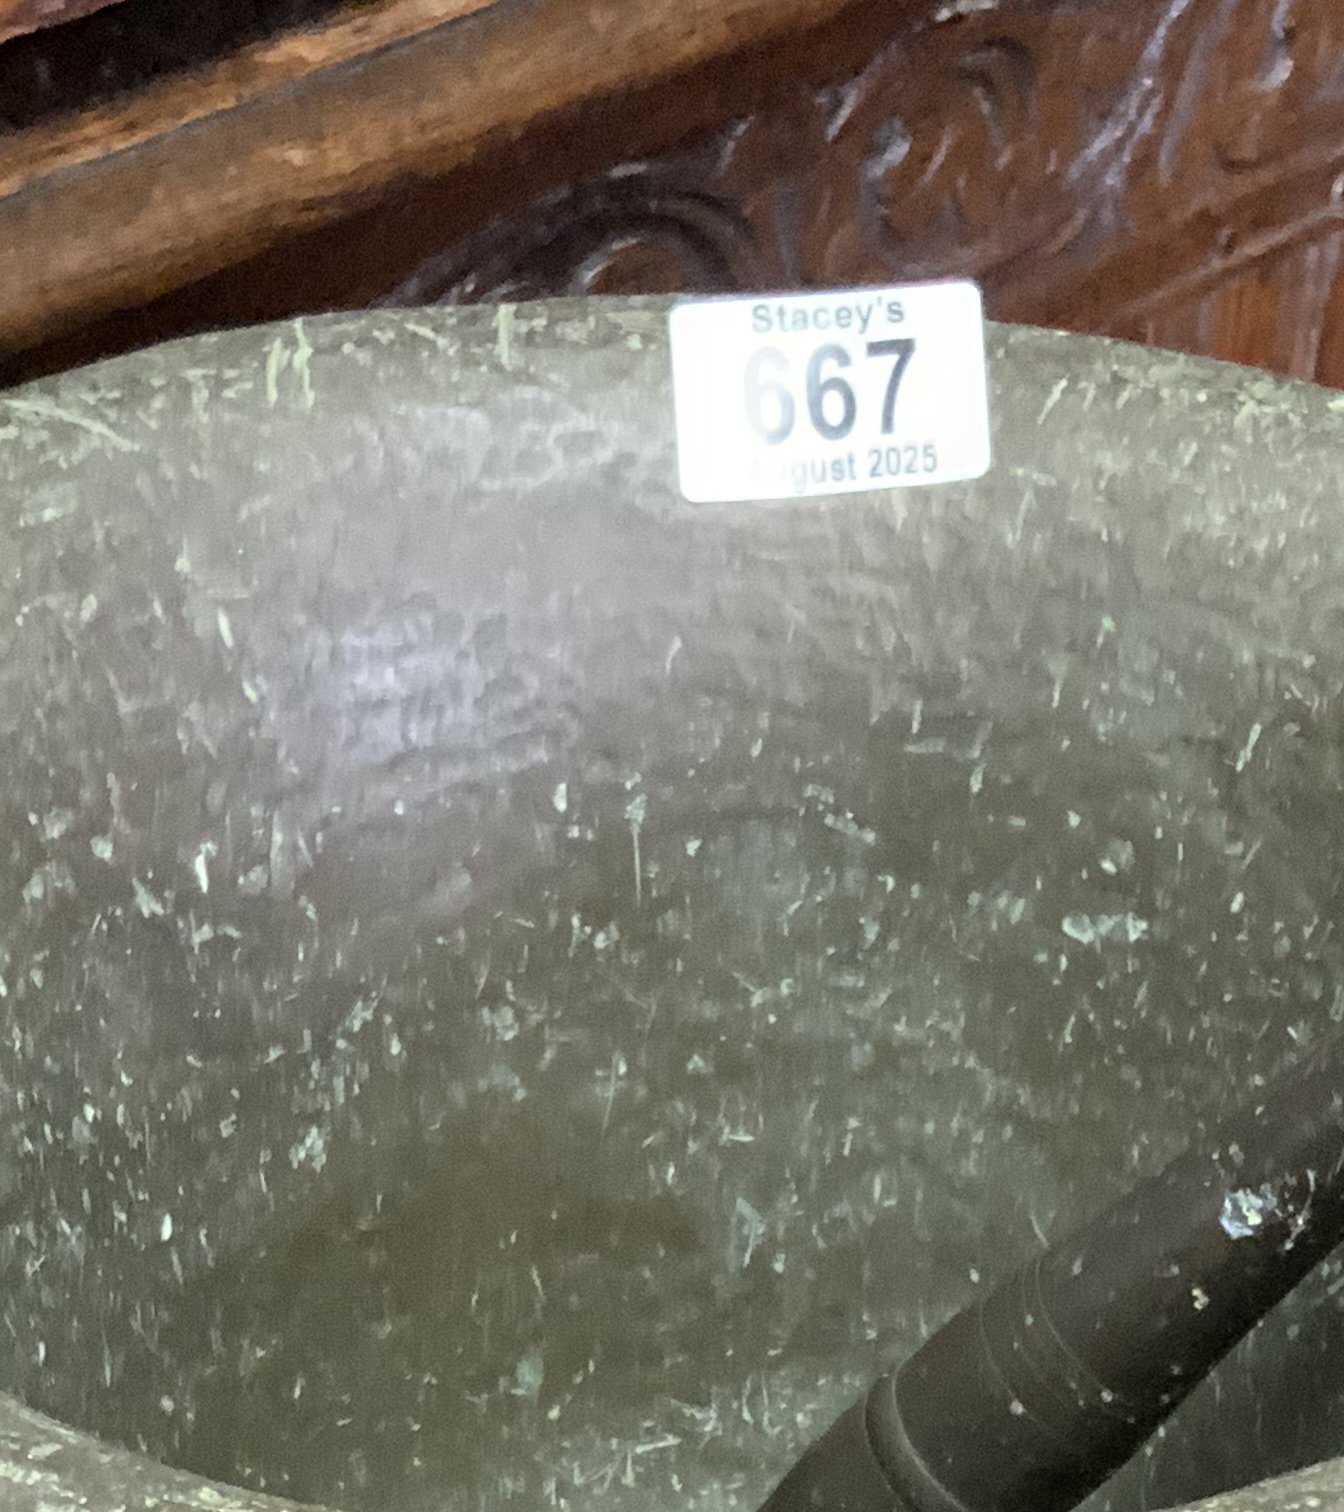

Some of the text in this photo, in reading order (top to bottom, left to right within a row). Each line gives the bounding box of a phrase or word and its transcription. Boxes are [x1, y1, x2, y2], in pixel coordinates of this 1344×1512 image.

[751, 296, 905, 334] Stacey's
[744, 337, 916, 446] 667
[868, 443, 938, 478] 2025
